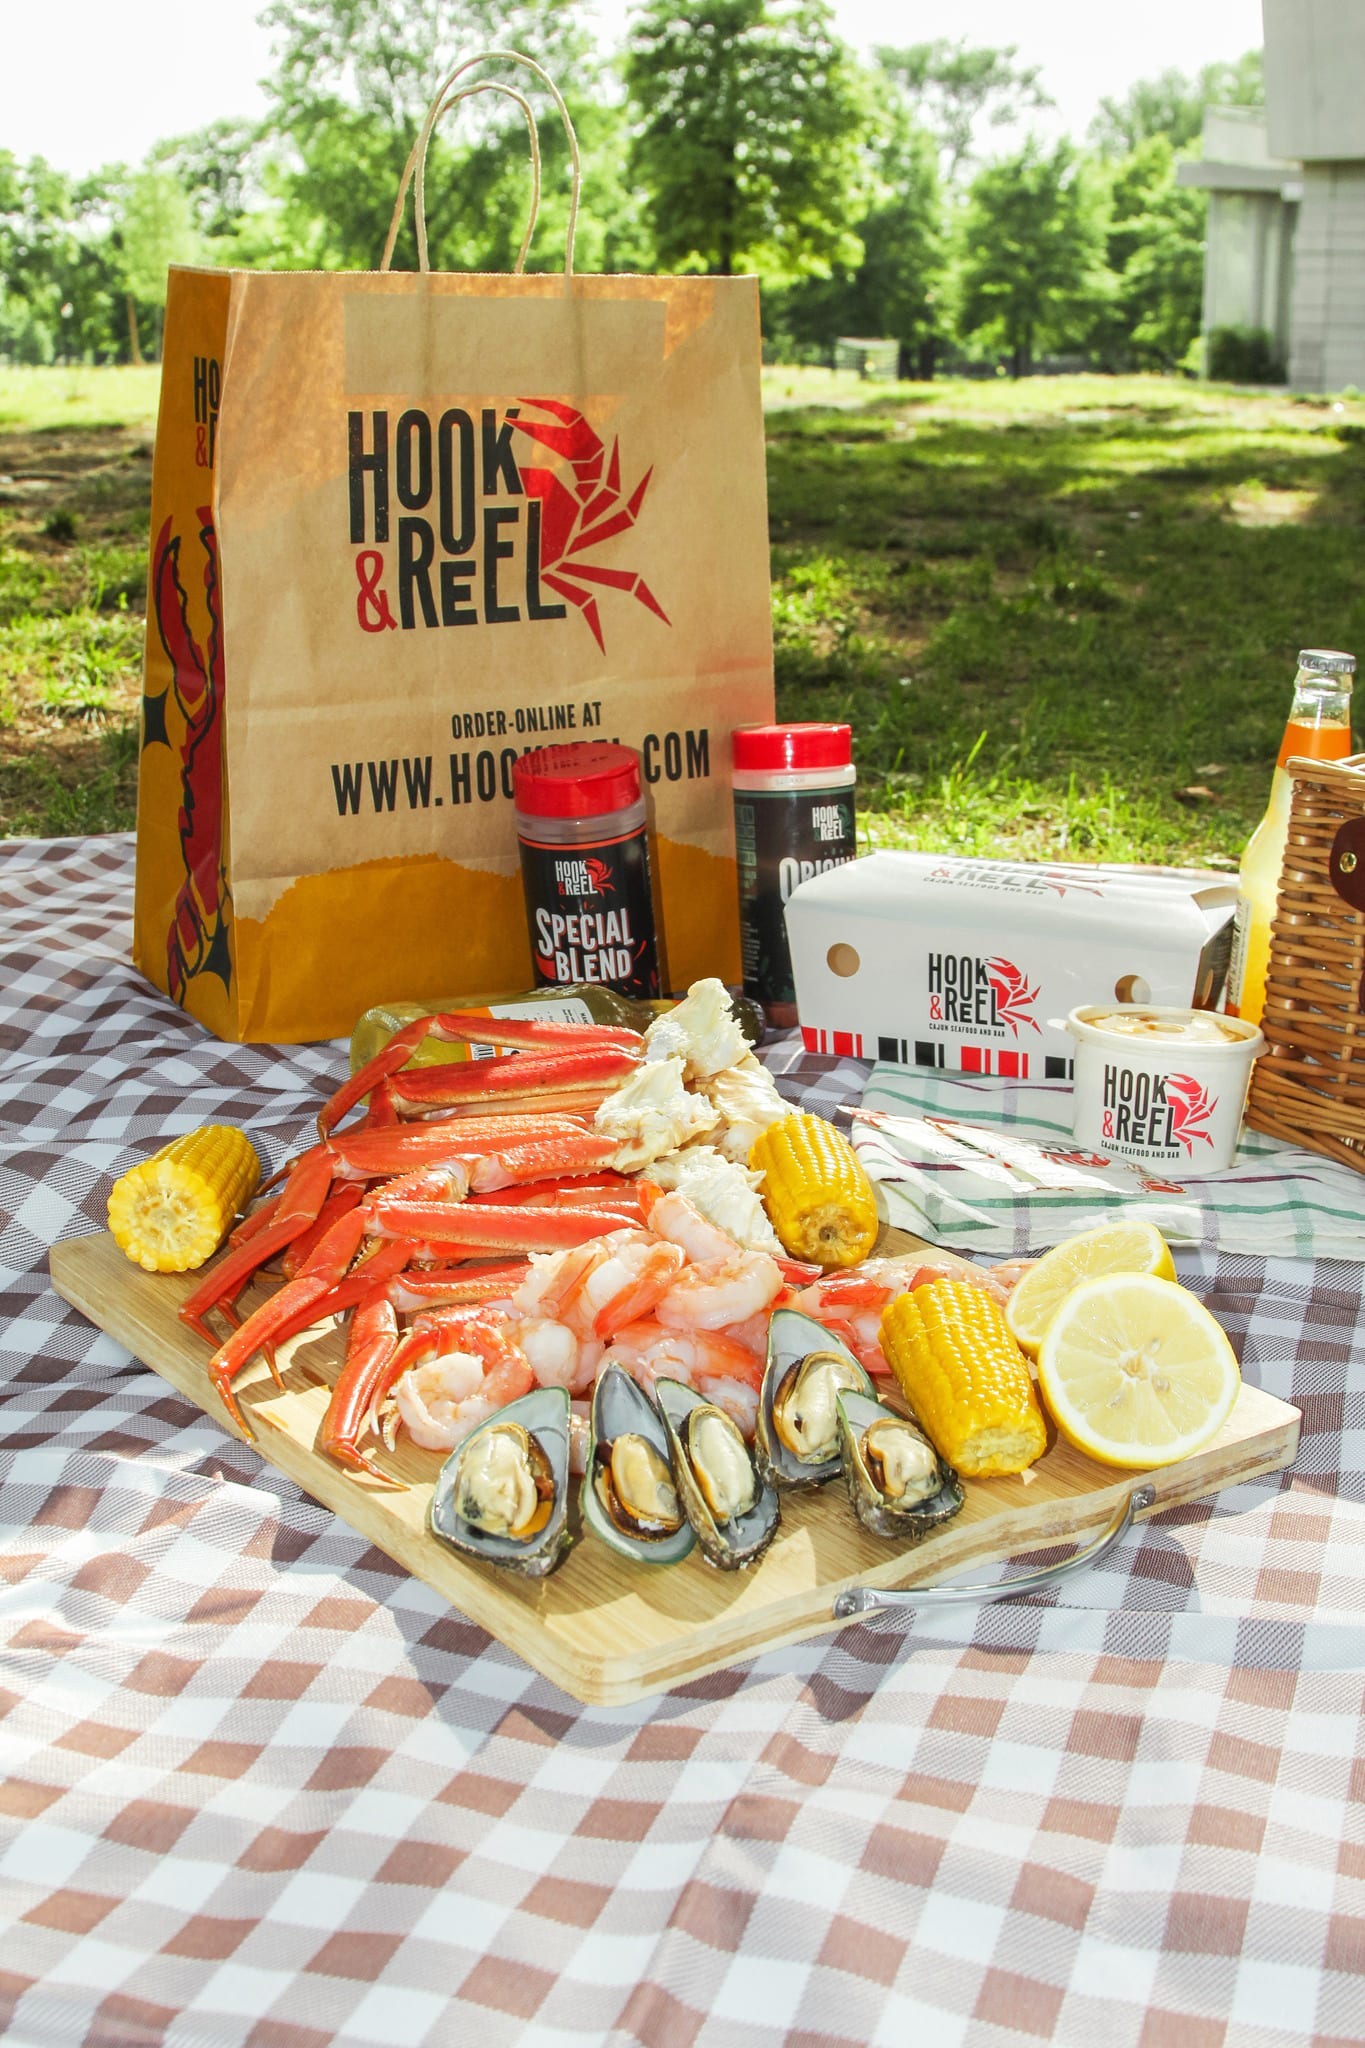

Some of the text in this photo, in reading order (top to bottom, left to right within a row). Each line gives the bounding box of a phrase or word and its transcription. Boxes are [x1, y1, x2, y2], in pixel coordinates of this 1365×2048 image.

[347, 408, 523, 555] HOOK
[451, 701, 602, 739] ORDER-ONLINE AT
[811, 804, 839, 829] HOOK
[554, 859, 587, 884] HOOK
[536, 907, 635, 957] SPECIAL
[555, 947, 632, 983] BLEND
[928, 952, 989, 1002] HOOK
[929, 1022, 1005, 1038] CAJUN SEAFOOD AND BAR
[1103, 1064, 1169, 1121] HOOK
[1100, 1140, 1119, 1152] CAJUN
[1121, 1145, 1150, 1158] SEAFOOD
[1152, 1151, 1165, 1159] AND
[1167, 1151, 1180, 1159] BAR
